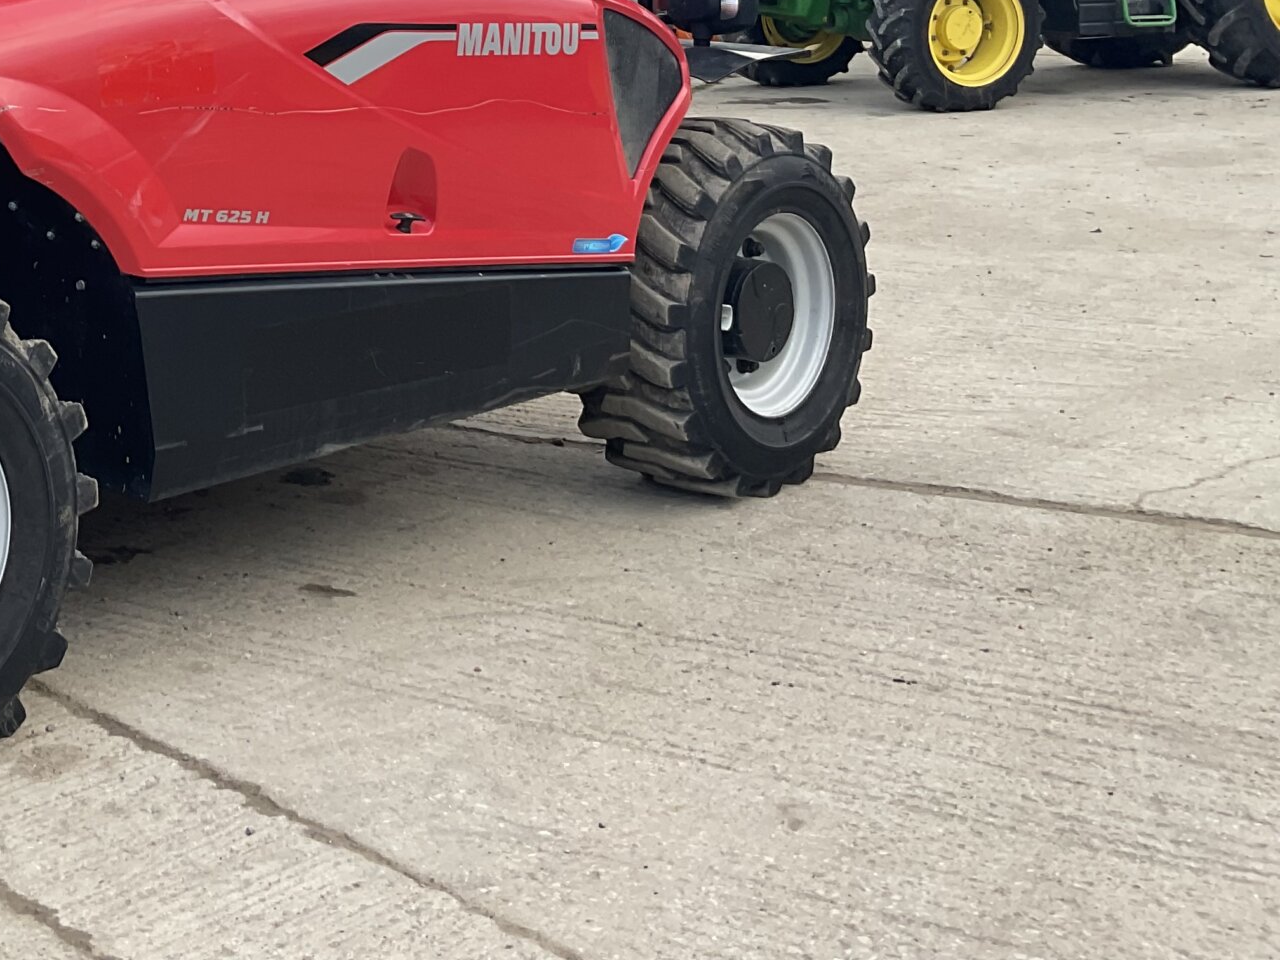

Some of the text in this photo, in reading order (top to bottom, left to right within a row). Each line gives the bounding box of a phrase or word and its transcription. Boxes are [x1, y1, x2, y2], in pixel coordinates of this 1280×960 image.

[456, 22, 579, 56] MANITOU
[183, 208, 270, 224] MT 625 H
